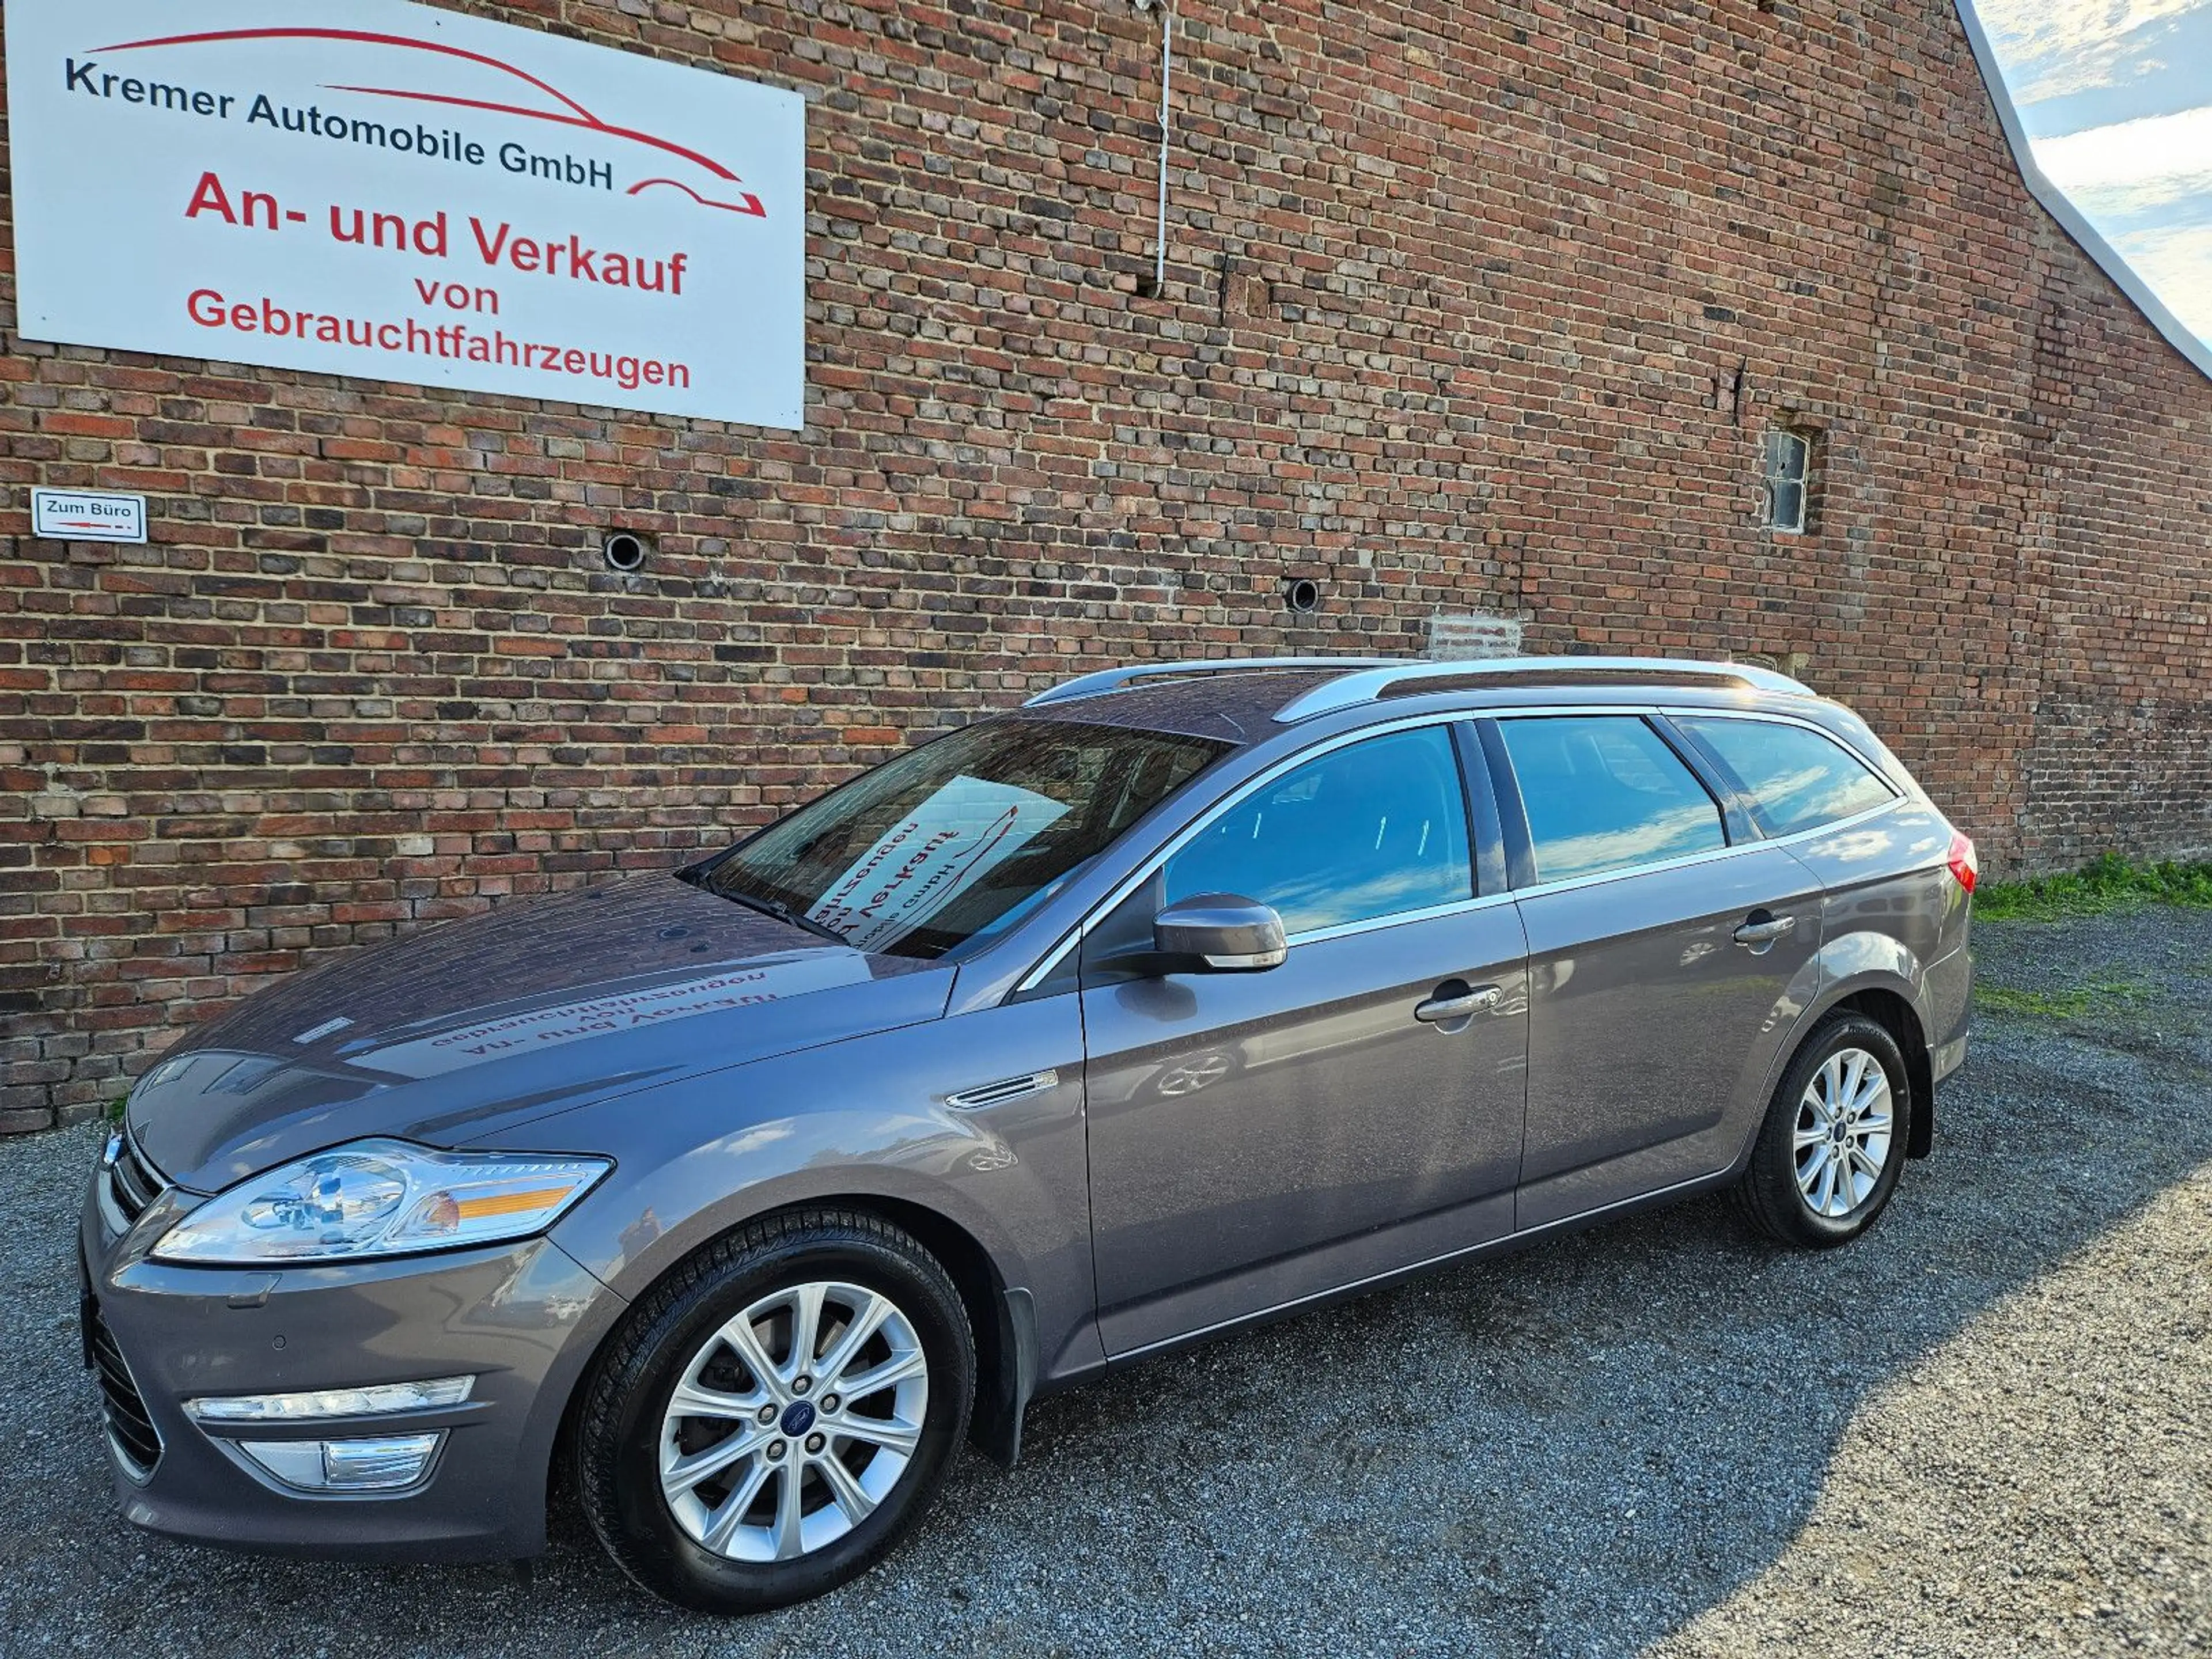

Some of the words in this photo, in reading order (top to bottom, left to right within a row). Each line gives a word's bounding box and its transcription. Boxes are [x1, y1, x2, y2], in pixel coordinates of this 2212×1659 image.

[65, 57, 236, 119] Kremer
[246, 93, 486, 166] Automobile
[498, 142, 612, 191] GmbH
[184, 171, 307, 232] An-
[329, 204, 448, 259] und
[468, 216, 688, 296] Verkauf
[187, 288, 690, 391] Gebrauchtfahrzeugen
[414, 277, 499, 316] von
[47, 500, 84, 514] Zum
[90, 503, 131, 517] Büro
